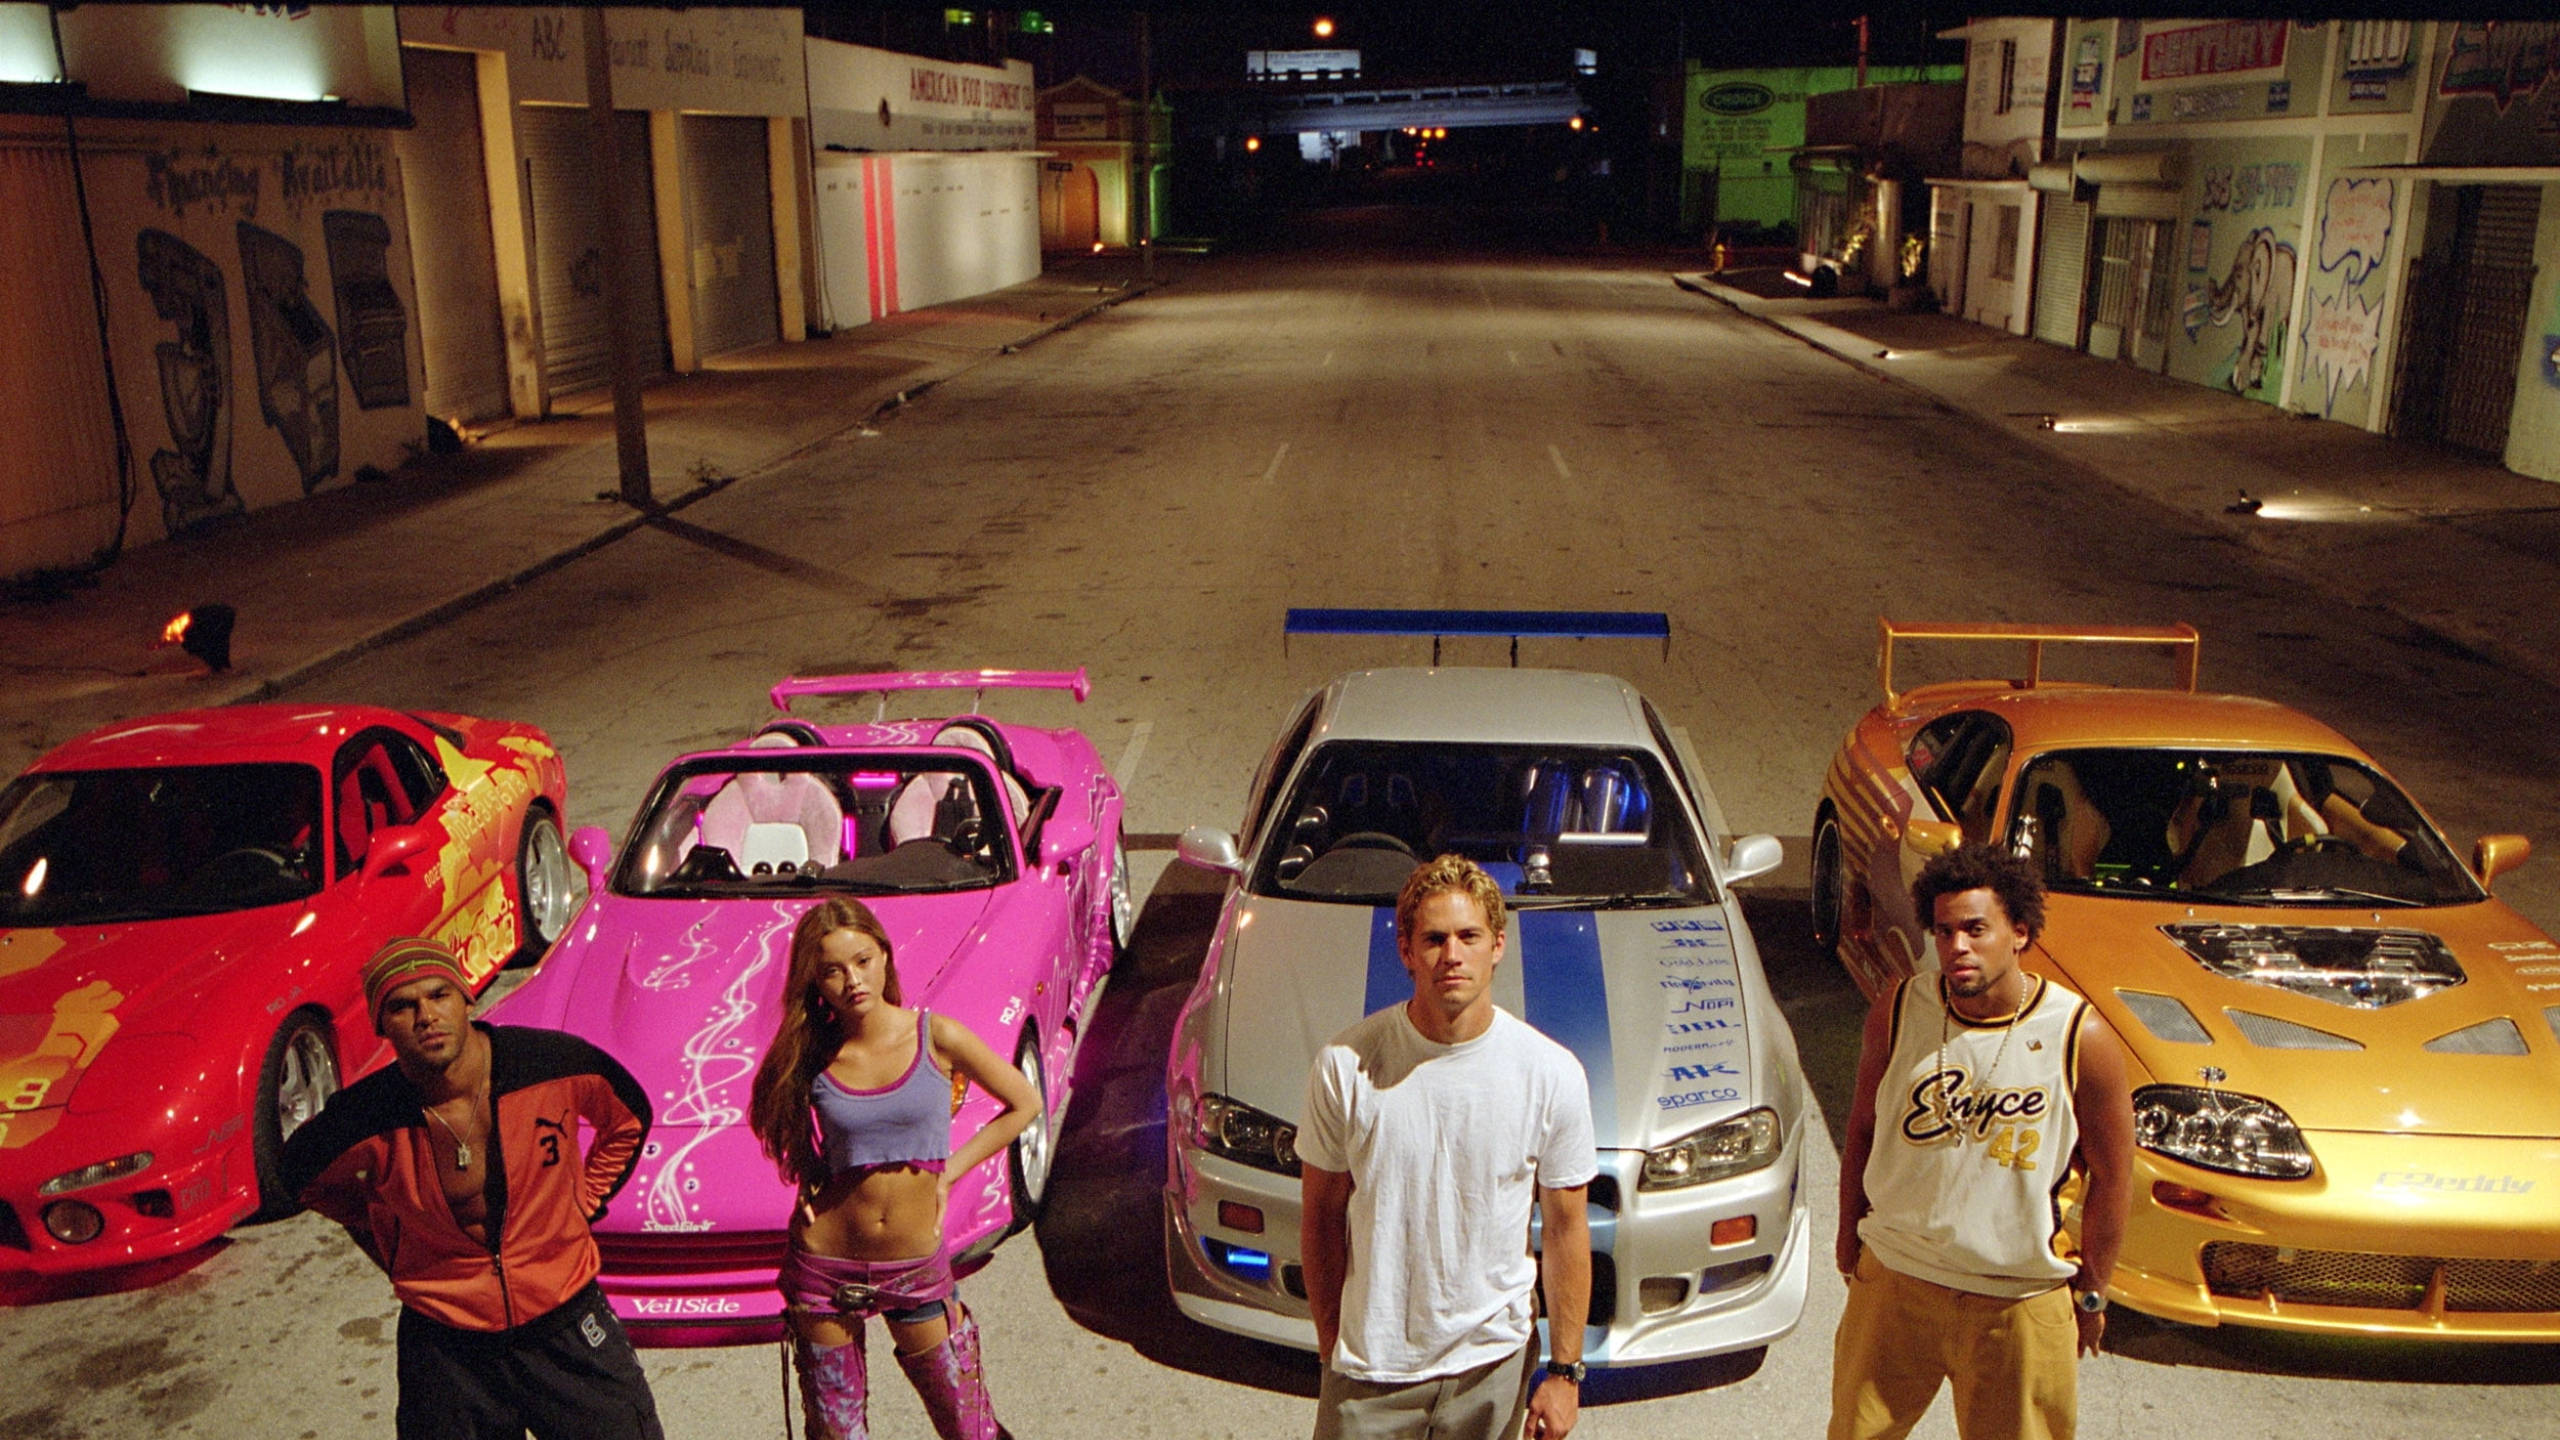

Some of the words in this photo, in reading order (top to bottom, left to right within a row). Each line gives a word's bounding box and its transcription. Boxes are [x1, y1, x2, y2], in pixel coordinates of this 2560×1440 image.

[910, 67, 958, 104] AMERICAN
[961, 76, 981, 107] FOOD
[1657, 1087, 1738, 1109] sparco
[1902, 1068, 2048, 1143] Enyce
[540, 1133, 560, 1169] 3
[1987, 1126, 2041, 1171] 42
[631, 1298, 740, 1314] VeilSide
